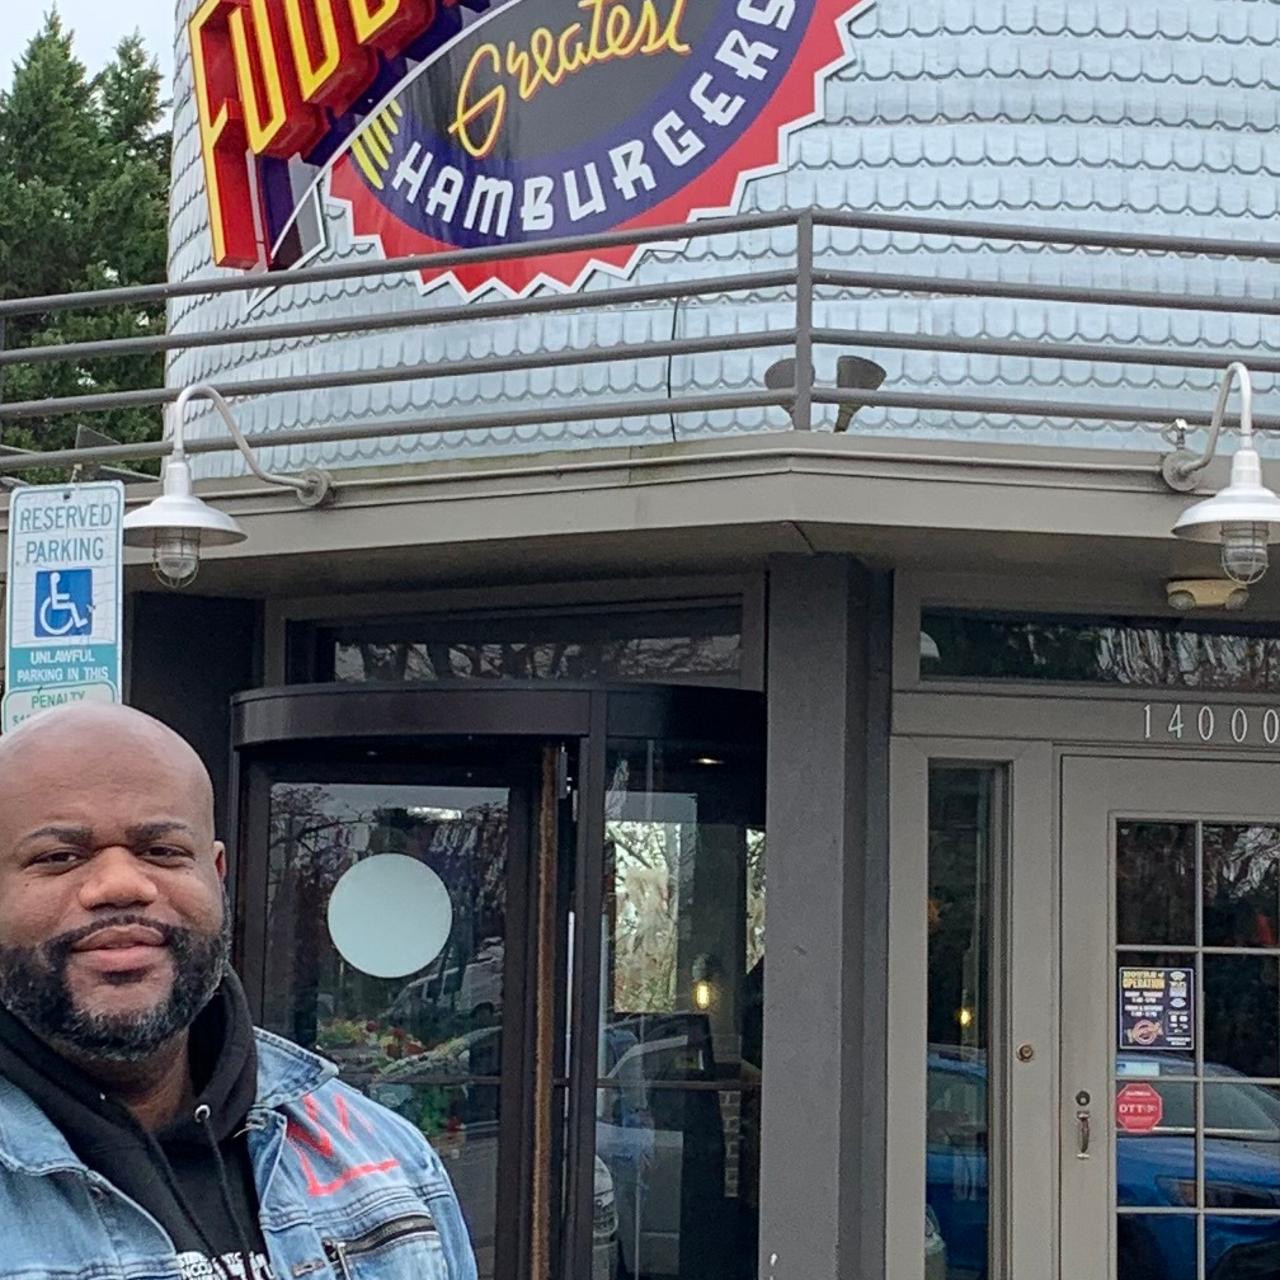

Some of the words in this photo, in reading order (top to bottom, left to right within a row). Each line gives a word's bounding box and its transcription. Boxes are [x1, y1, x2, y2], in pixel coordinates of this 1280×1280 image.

[20, 503, 112, 531] RESERVED
[26, 537, 104, 564] PARKING
[30, 649, 95, 665] UNLAWFUL
[17, 668, 63, 683] PARKING
[67, 668, 79, 681] IN
[83, 666, 109, 680] THIS
[1142, 705, 1280, 744] 14000
